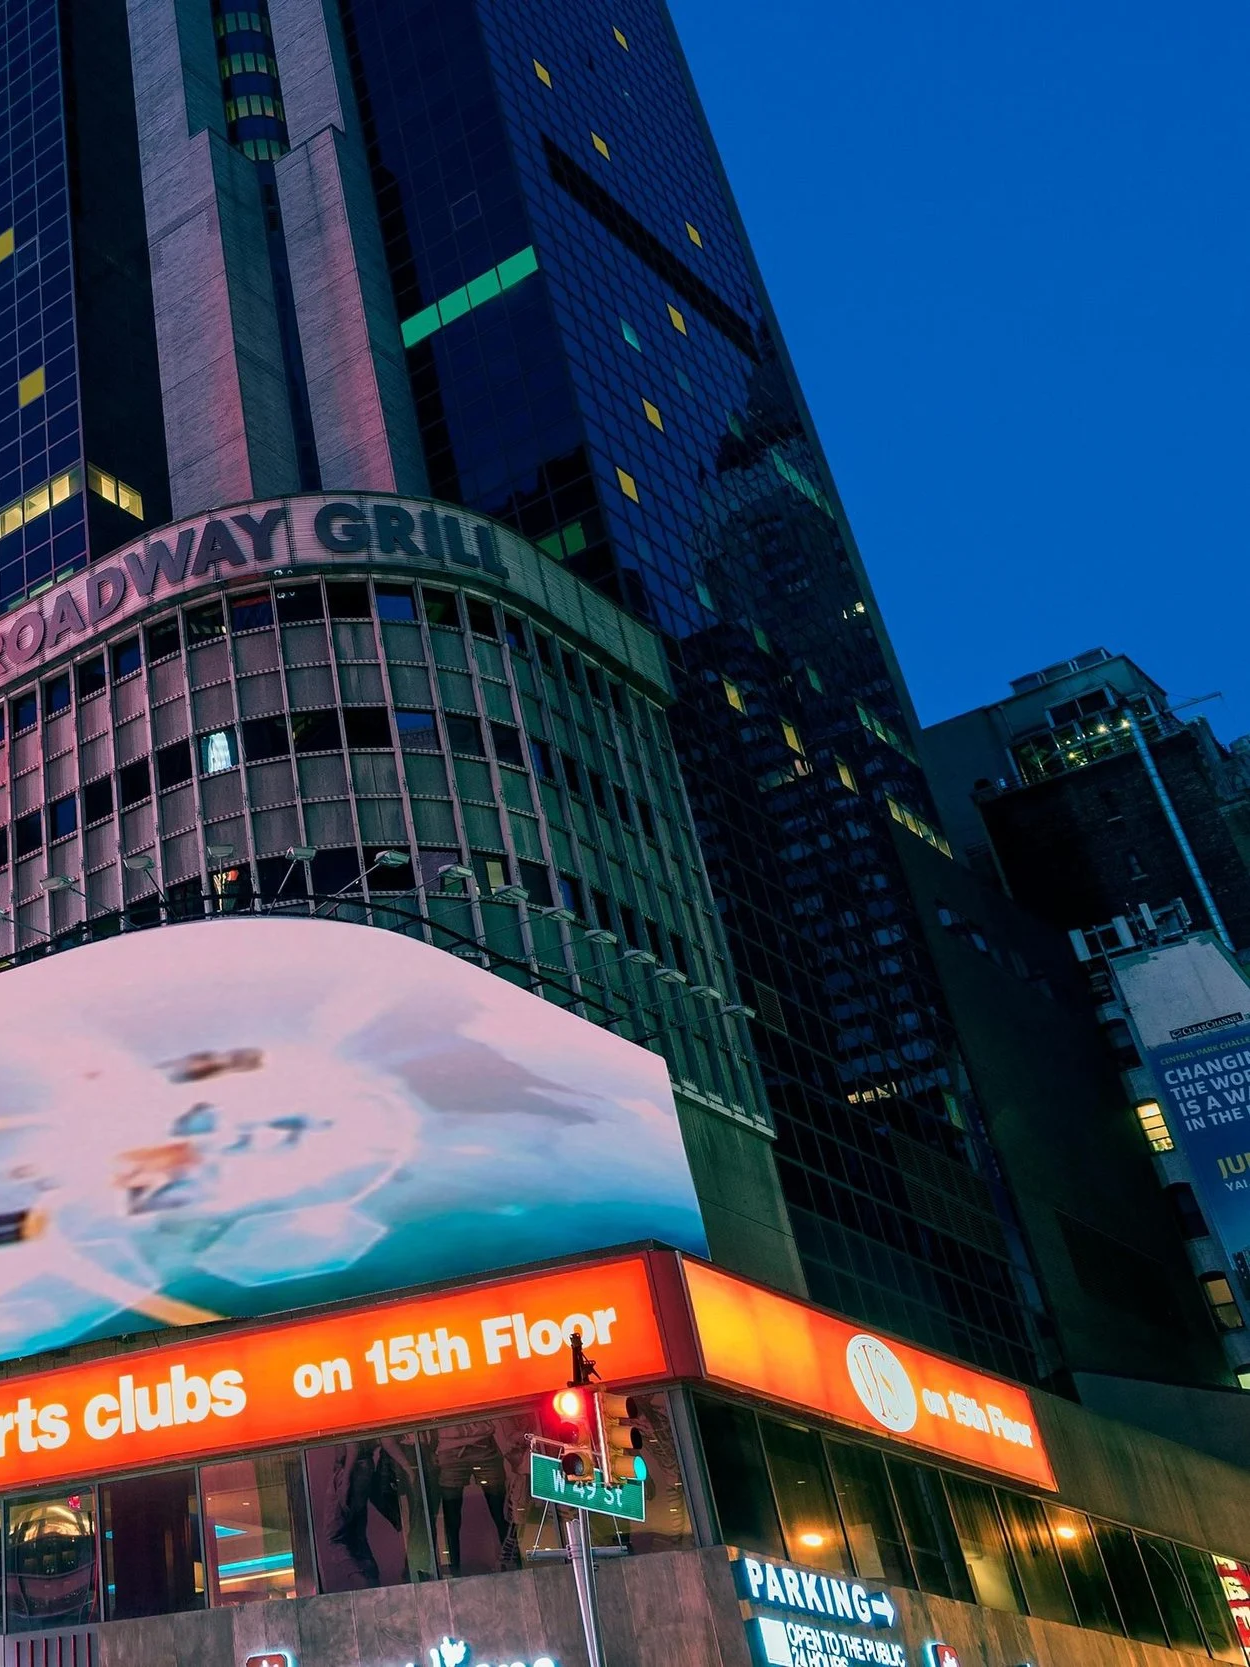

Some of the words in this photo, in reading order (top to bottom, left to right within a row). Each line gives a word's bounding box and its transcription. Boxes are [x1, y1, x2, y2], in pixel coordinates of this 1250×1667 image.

[314, 502, 510, 580] GRILL
[1160, 1051, 1195, 1066] CENTRAL
[1196, 1044, 1219, 1055] PARK
[1170, 1081, 1208, 1101] THE
[1178, 1100, 1201, 1117] IS
[1207, 1094, 1223, 1111] A
[1185, 1116, 1206, 1132] IN
[1207, 1107, 1244, 1126] THE
[293, 1357, 352, 1398] on
[366, 1333, 471, 1386] 15th
[481, 1306, 617, 1365] Floor
[83, 1364, 247, 1440] clubs
[922, 1388, 949, 1419] on
[948, 1391, 991, 1434] 15th
[986, 1403, 1034, 1449] Floor
[552, 1468, 566, 1495] W
[573, 1480, 597, 1501] 49
[603, 1485, 623, 1508] St
[745, 1558, 873, 1624] PARKING
[786, 1622, 823, 1652] OPEN
[820, 1630, 840, 1656] TO
[838, 1634, 866, 1661] THE
[862, 1638, 906, 1667] PUBLIC
[791, 1646, 808, 1667] 24
